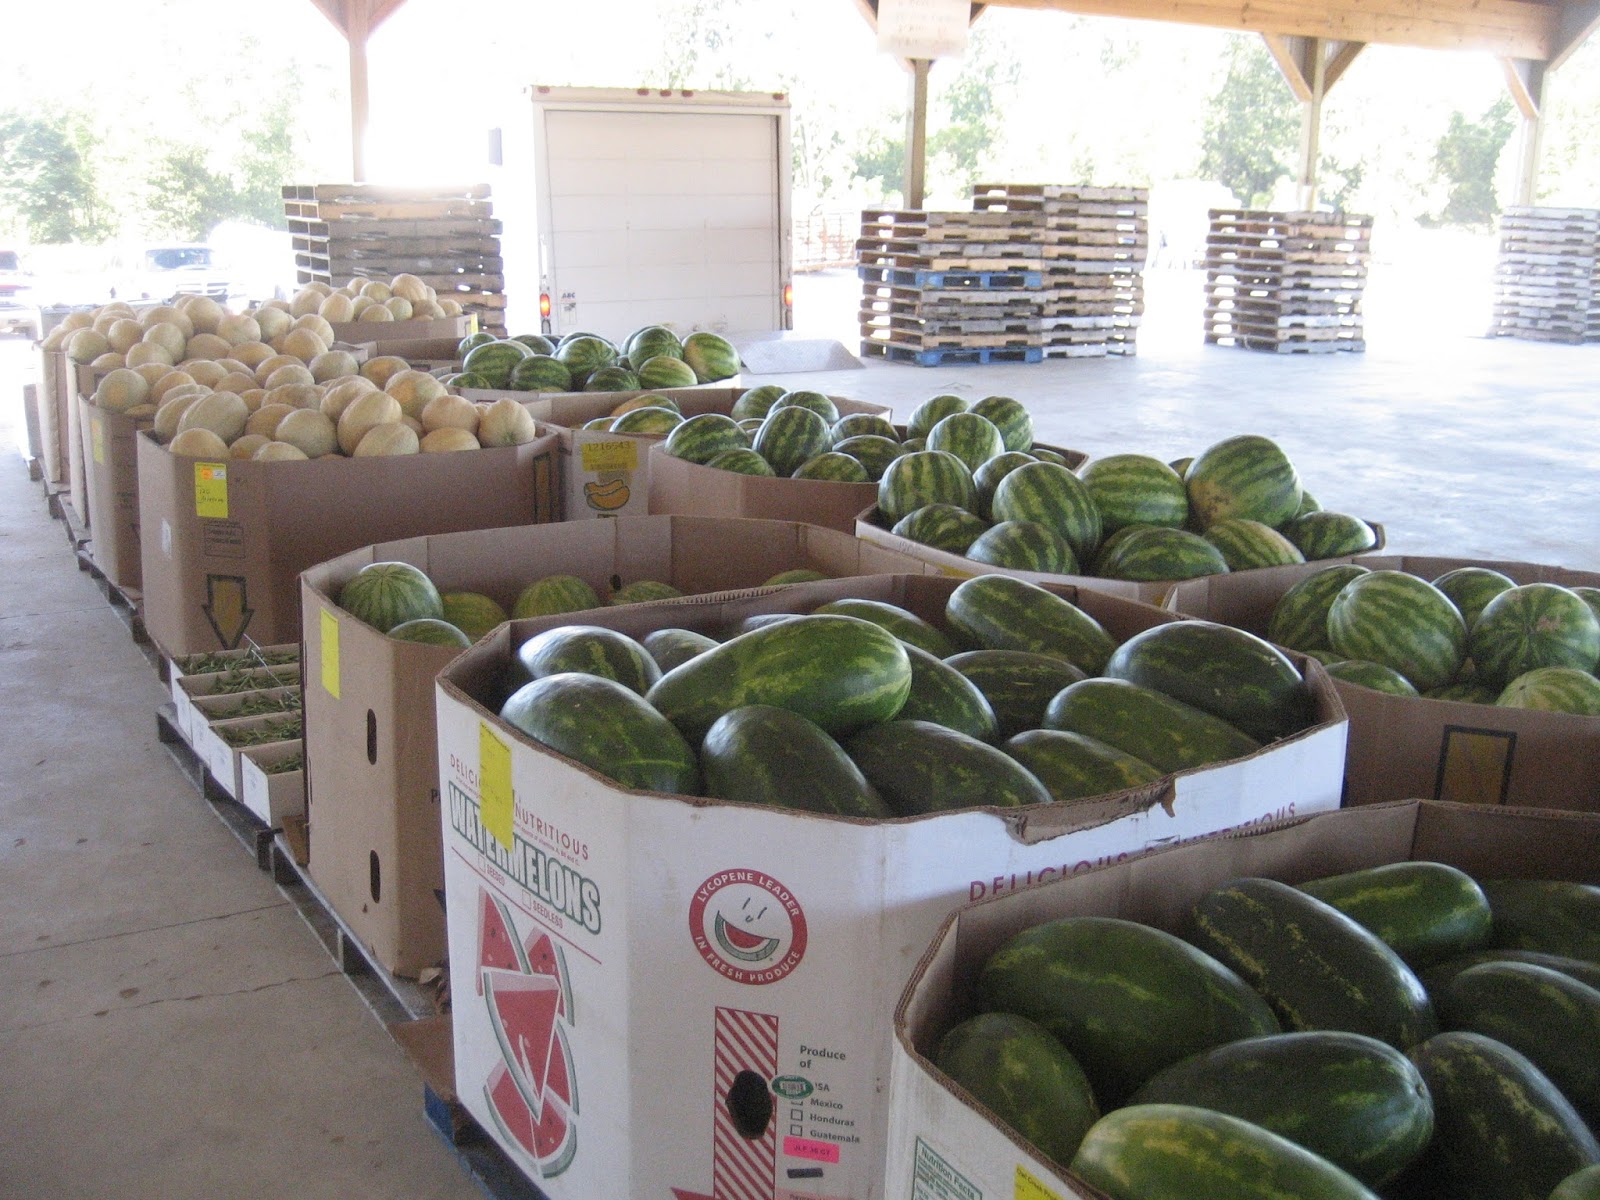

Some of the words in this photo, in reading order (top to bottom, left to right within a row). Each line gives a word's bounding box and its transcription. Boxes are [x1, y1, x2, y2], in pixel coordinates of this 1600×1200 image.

[515, 803, 588, 860] NUTRITIOUS
[697, 872, 754, 903] LYCOPENE
[759, 876, 800, 917] LEADER
[533, 901, 563, 929] SEEDLESS
[696, 936, 708, 949] IN
[706, 953, 743, 980] FRESH
[749, 951, 800, 982] PRODUCE
[800, 1045, 847, 1060] Produce
[800, 1059, 812, 1069] of
[815, 1083, 830, 1092] SA
[810, 1098, 843, 1110] Mexico
[809, 1113, 855, 1127] Honduras
[810, 1129, 861, 1143] Guatemala
[921, 1147, 953, 1180] Nutrition
